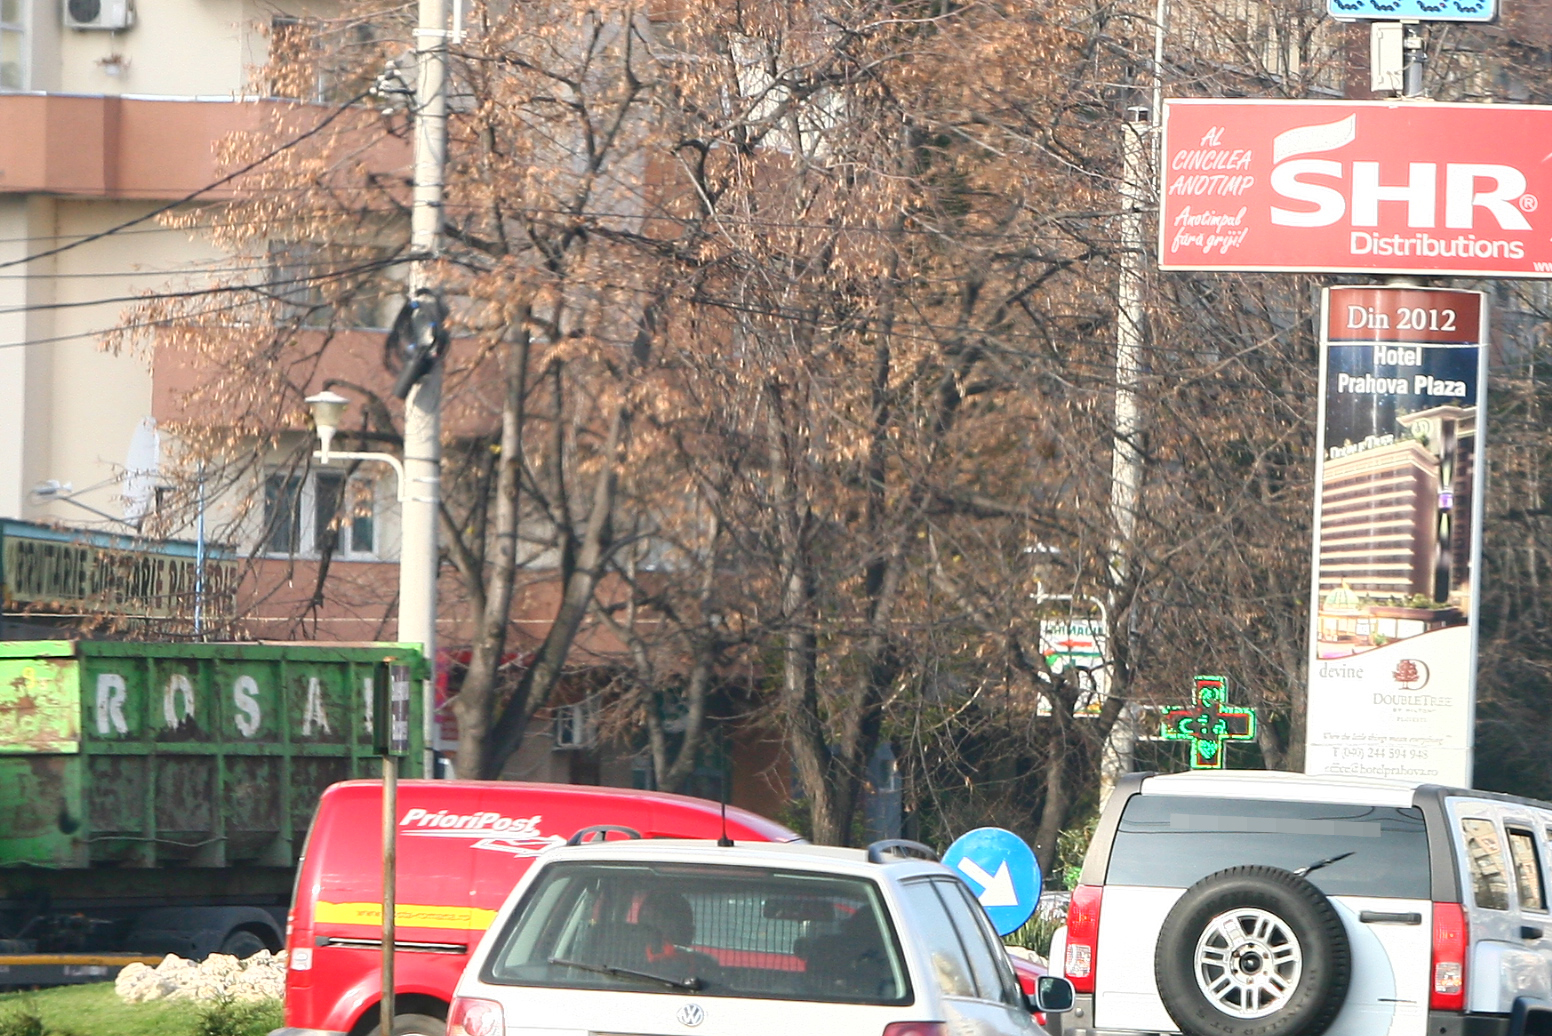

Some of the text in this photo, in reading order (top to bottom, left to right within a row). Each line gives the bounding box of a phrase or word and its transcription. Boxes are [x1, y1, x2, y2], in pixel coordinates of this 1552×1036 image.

[1200, 126, 1225, 147] AL
[1172, 149, 1252, 171] CINCILEA
[1169, 174, 1255, 196] ANOTIMP
[1270, 158, 1533, 230] SHR
[1350, 232, 1525, 259] Distributions
[1347, 305, 1457, 331] Din 2012
[1373, 346, 1422, 367] Hotel
[1337, 373, 1467, 397] Prahova Plaza
[1319, 662, 1364, 679] devine
[399, 808, 542, 832] PrioriPost
